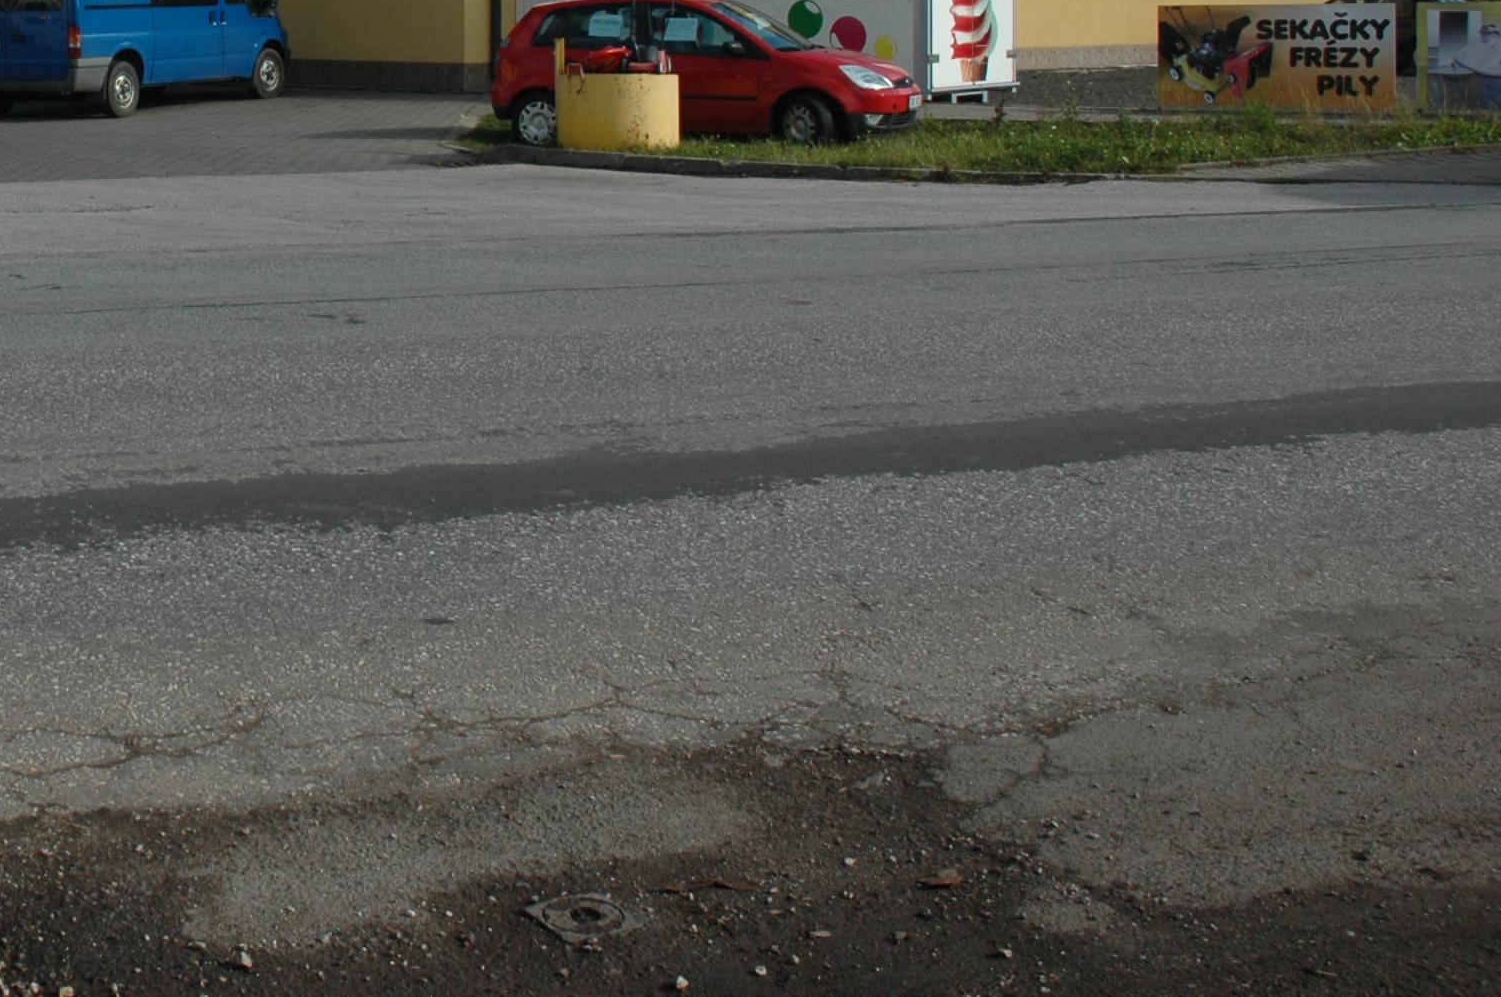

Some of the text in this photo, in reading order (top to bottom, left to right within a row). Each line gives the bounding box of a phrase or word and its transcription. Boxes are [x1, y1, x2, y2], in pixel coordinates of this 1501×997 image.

[1256, 11, 1390, 40] SEKAČKY
[1289, 39, 1380, 69] FRÉZY
[1316, 74, 1380, 97] PILY
